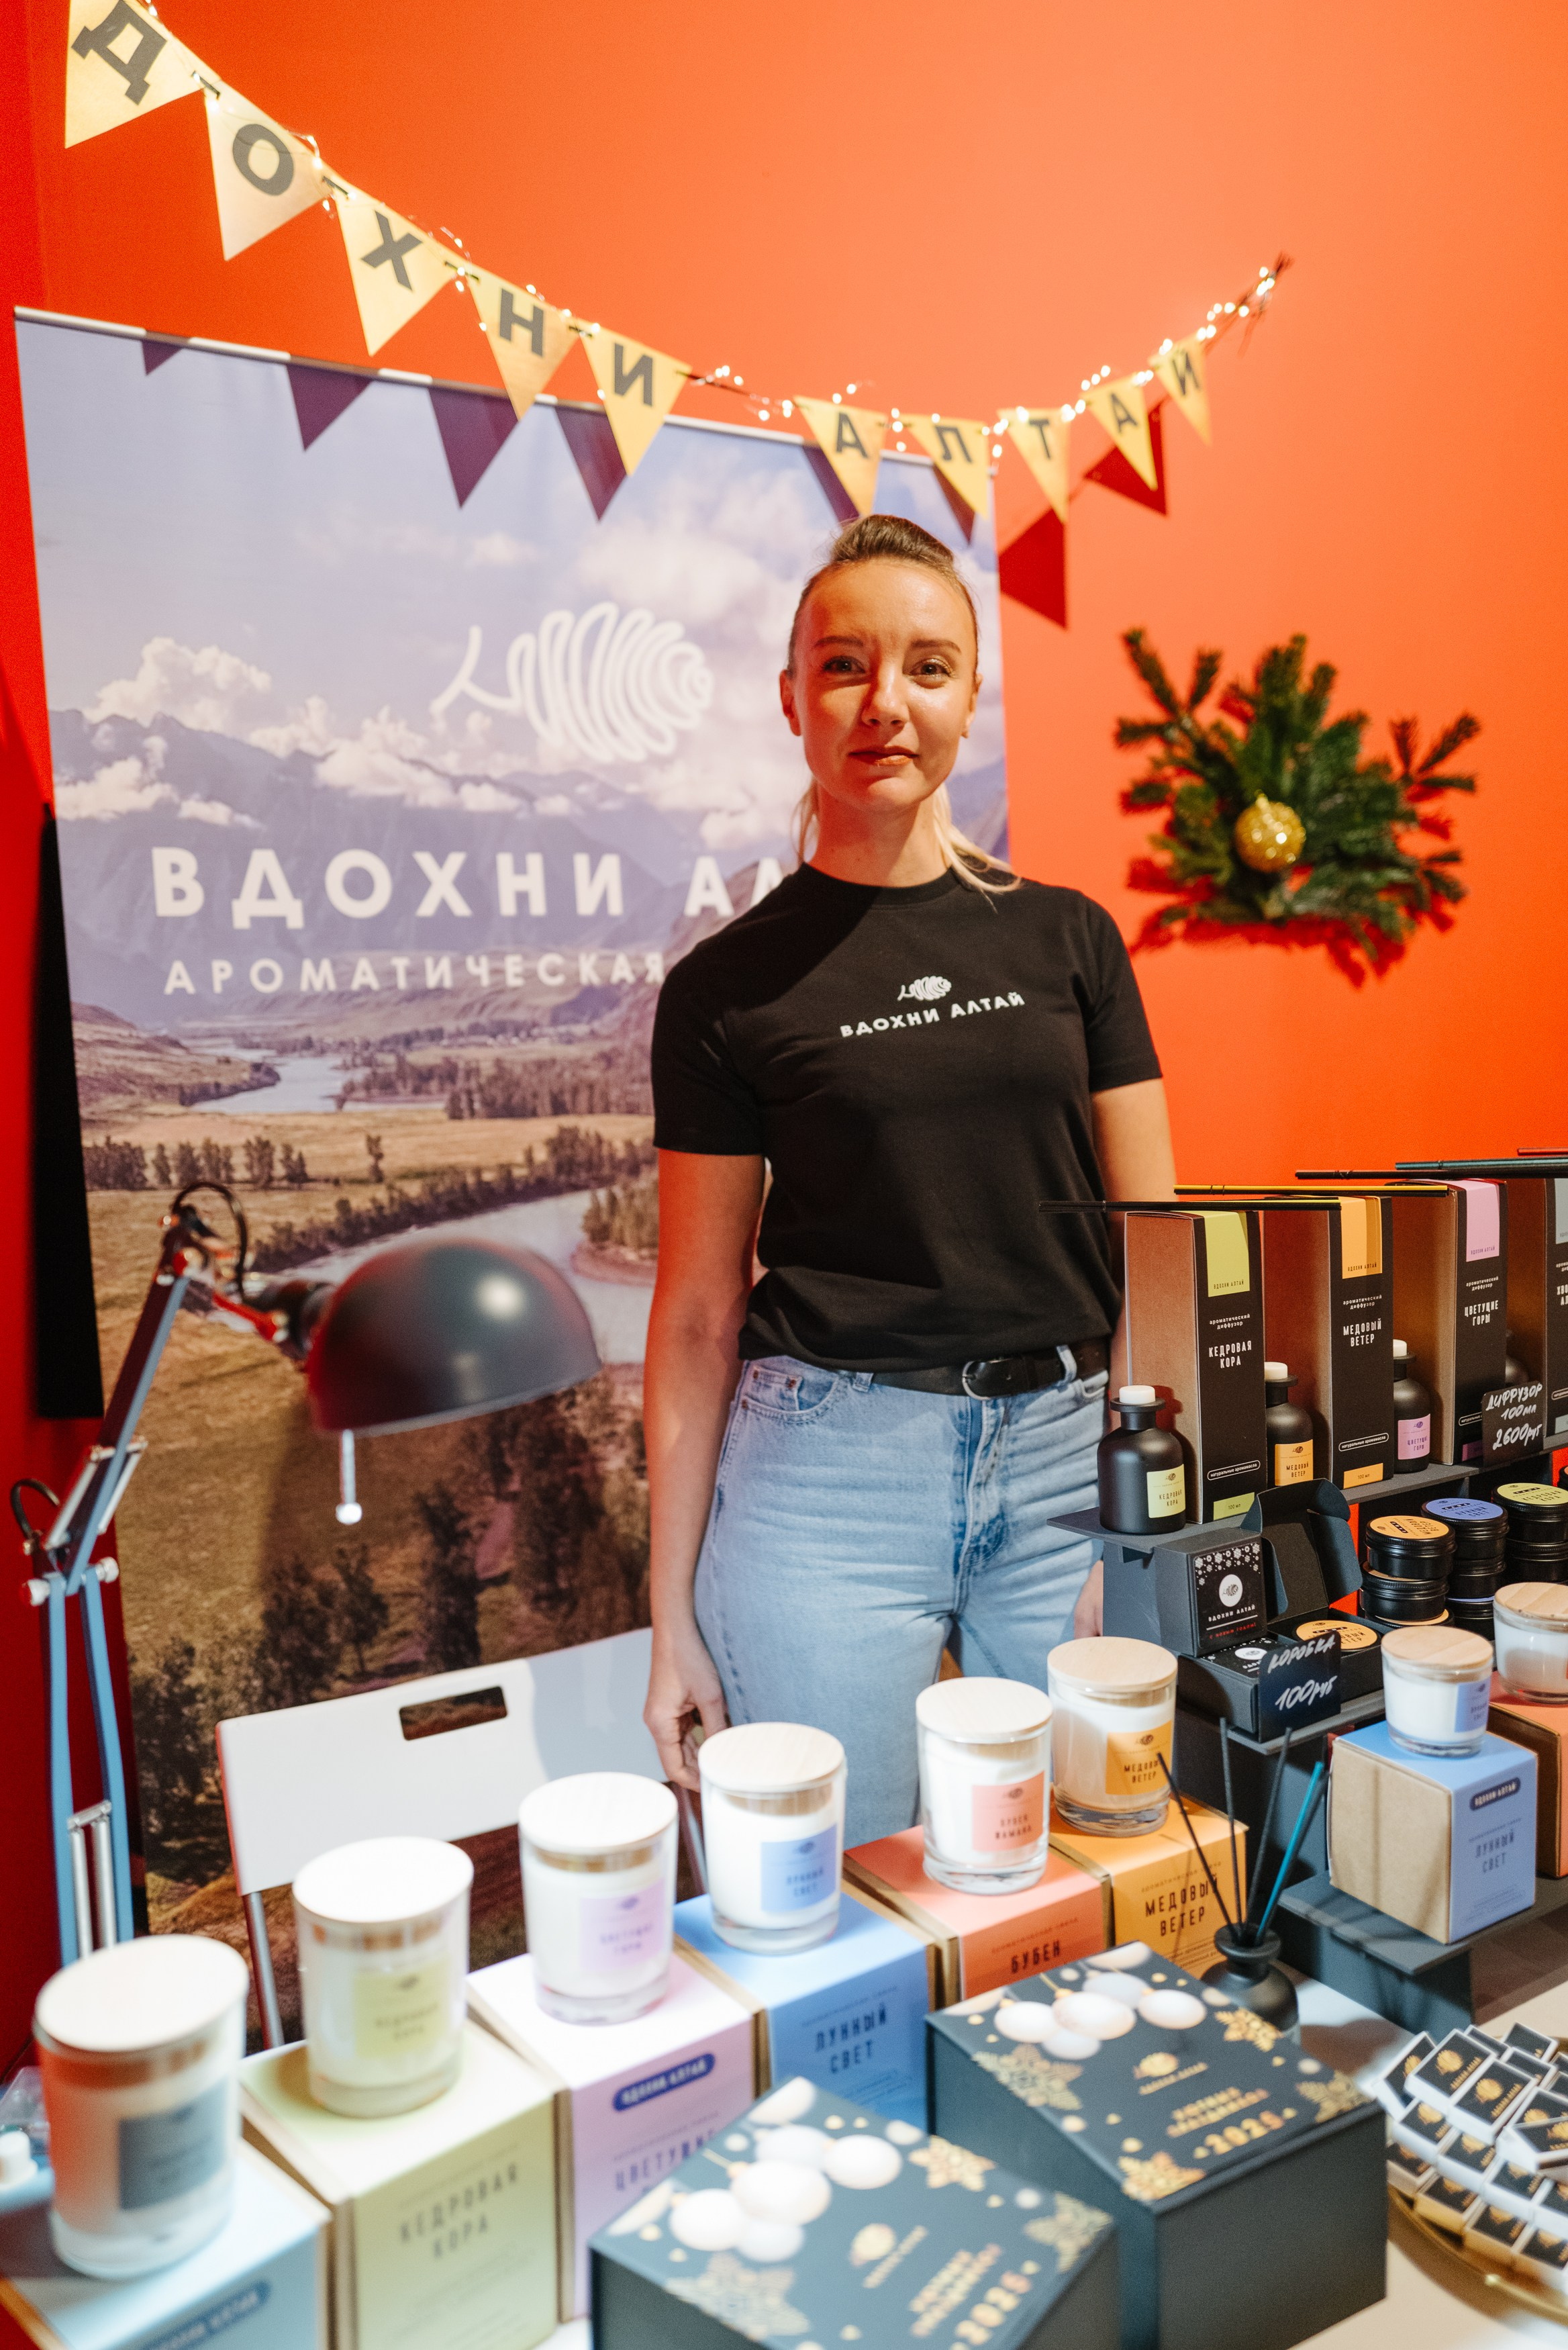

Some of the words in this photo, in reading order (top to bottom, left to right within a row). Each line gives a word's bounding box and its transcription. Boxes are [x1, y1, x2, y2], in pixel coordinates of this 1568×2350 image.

[152, 847, 624, 931] ВДОХНИ
[164, 952, 665, 996] АРОМАТИЧЕСКАЯ
[840, 1008, 940, 1037] ВДОХНИ
[950, 991, 1025, 1019] АЛТАЙ
[1231, 1279, 1244, 1287] АЛТАЙ
[1466, 1276, 1499, 1287] ароматический
[1471, 1282, 1493, 1291] диффузор
[1343, 1295, 1382, 1305] ароматический
[1350, 1301, 1375, 1310] диффузор
[1465, 1300, 1499, 1317] ЦВЕТУЩИЕ
[1210, 1313, 1251, 1325] ароматический
[1217, 1321, 1243, 1330] диффузор
[1343, 1317, 1381, 1335] МЕДОВЫЙ
[1472, 1313, 1491, 1326] ГОРЫ
[1351, 1333, 1375, 1347] ВЕТЕР
[1209, 1340, 1252, 1358] КЕДРОВАЯ
[1220, 1356, 1241, 1369] КОРА
[1501, 1404, 1536, 1420] 100мл
[1210, 1468, 1234, 1478] натуральные
[1234, 1463, 1257, 1474] аромамасла
[1286, 1461, 1309, 1470] МЕДОВЫЙ
[1159, 1489, 1182, 1500] КЕДРОВАЯ
[1208, 1611, 1234, 1622] ВДОХНИ
[1236, 1604, 1255, 1614] АЛТАЙ
[1267, 1634, 1336, 1674] КОРОБКА
[1482, 1852, 1506, 1873] СВЕТ
[1160, 1906, 1205, 1936] ВЕТЕР
[1010, 1939, 1061, 1974] БУБЕН
[816, 2002, 887, 2053] ЛУННЫЙ
[830, 2038, 873, 2074] СВЕТ
[400, 2163, 517, 2243] КЕДРОВАЯ
[434, 2214, 487, 2259] КОРА
